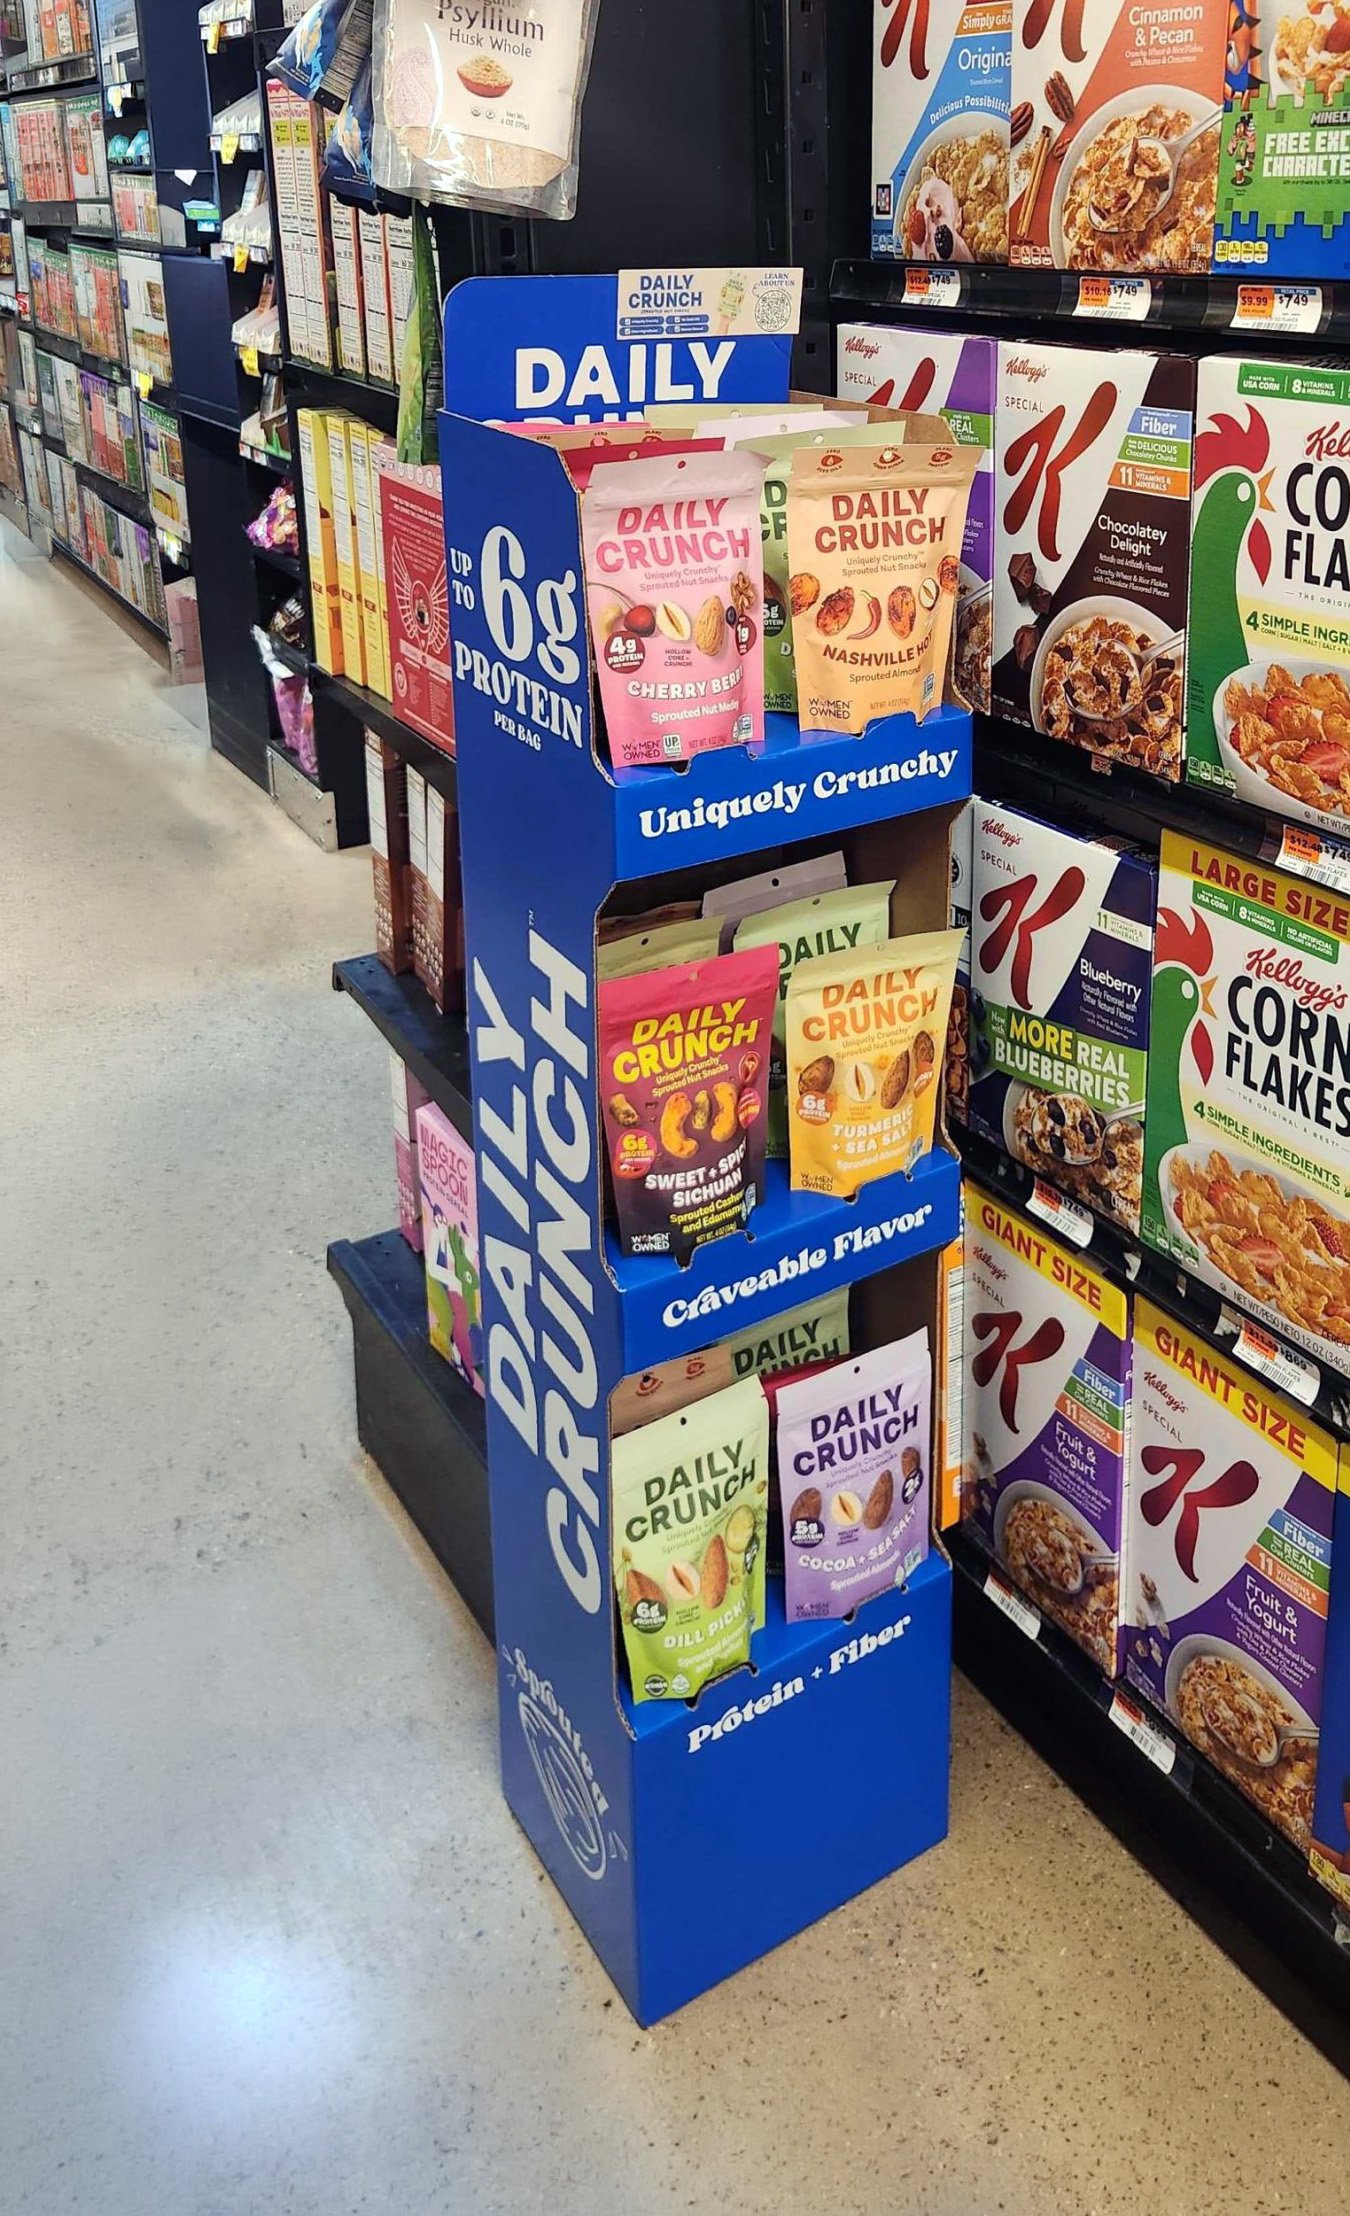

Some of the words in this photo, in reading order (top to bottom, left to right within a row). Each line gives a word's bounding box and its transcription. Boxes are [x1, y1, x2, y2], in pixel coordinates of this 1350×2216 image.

[438, 0, 544, 41] Psyllium
[962, 14, 995, 30] Simply
[1129, 4, 1203, 25] Cinnamon
[449, 28, 484, 47] Husk
[489, 36, 533, 58] Whole
[1135, 30, 1147, 46] &
[1150, 27, 1194, 47] Pecan
[930, 99, 963, 125] Delicious
[1265, 131, 1311, 155] FREE
[640, 274, 695, 291] DAILY
[764, 272, 789, 280] LEARN
[628, 292, 703, 309] CRUNCH
[1241, 295, 1268, 307] $9.99
[844, 336, 882, 358] Kellogg's
[515, 341, 737, 410] DAILY
[844, 371, 877, 387] SPECIAL
[1005, 358, 1050, 383] Kellogg's
[1242, 380, 1258, 389] USA
[1258, 382, 1280, 391] CORN
[1292, 379, 1302, 394] 8
[1302, 380, 1334, 390] VITAMINS
[1004, 396, 1044, 414] SPECIAL
[950, 419, 974, 434] REAL
[1140, 416, 1177, 436] Fiber
[1125, 448, 1156, 461] Chocolatey
[1156, 453, 1178, 463] Chunks
[1138, 440, 1178, 455] DELICIOUS
[1120, 466, 1133, 486] 11
[1135, 471, 1166, 485] VITAMINS
[1135, 479, 1167, 492] MINERALS
[617, 497, 729, 535] DAILY
[832, 488, 930, 522] DAILY
[814, 516, 946, 554] CRUNCH
[1098, 514, 1168, 546] Chocolatey
[1110, 534, 1152, 557] Delight
[450, 547, 473, 577] UP
[595, 528, 750, 573] CRUNCH
[842, 565, 879, 577] Sprouted
[880, 563, 897, 572] Nut
[452, 579, 475, 611] TO
[480, 525, 581, 685] 6g
[1246, 610, 1259, 631] 4
[1262, 613, 1310, 636] SIMPLE
[607, 653, 644, 665] PROTEIN
[610, 636, 637, 655] 4g
[823, 644, 914, 667] NASHVILLE
[454, 640, 583, 749] PROTEIN
[627, 681, 708, 699] CHERRY
[809, 707, 850, 719] OWNED
[493, 709, 516, 740] PER
[517, 725, 542, 752] BAG
[624, 749, 660, 760] OWNED
[639, 780, 807, 838] Uniquely
[813, 749, 959, 799] Crunchy
[981, 819, 1024, 847] Kellogg's
[980, 850, 1017, 876] SPECIAL
[1190, 850, 1278, 906] LARGE
[1285, 888, 1350, 936] SIZE
[1239, 906, 1248, 920] 8
[778, 923, 862, 970] DAILY
[1287, 926, 1298, 937] NO
[1298, 930, 1333, 951] ARTIFICIAL
[822, 966, 925, 1010] DAILY
[1080, 958, 1142, 1003] Blueberry
[1245, 948, 1349, 1012] Kellogg's
[631, 998, 747, 1045] DAILY
[801, 987, 938, 1042] CRUNCH
[991, 1010, 1006, 1024] Now
[1228, 975, 1350, 1083] CORN
[612, 1021, 759, 1084] CRUNCH
[1009, 1012, 1073, 1060] MORE
[1077, 1040, 1130, 1080] REAL
[652, 1077, 685, 1098] Sprouted
[685, 1073, 699, 1088] Nut
[699, 1064, 729, 1081] Snacks
[995, 1037, 1130, 1109] BLUEBERRIES
[1226, 1031, 1350, 1137] FLAKES
[802, 1094, 826, 1111] 6g
[832, 1103, 914, 1138] TURMERIC
[845, 1139, 878, 1154] SEA
[881, 1119, 914, 1145] SALT
[420, 1123, 468, 1175] MAGIC
[622, 1133, 648, 1150] 6g
[1193, 1100, 1206, 1119] 4
[1207, 1105, 1250, 1138] SIMPLE
[1252, 1131, 1341, 1187] INGREDIENTS
[421, 1150, 469, 1208] SPOON
[645, 1166, 707, 1190] SWEET
[672, 1168, 743, 1208] SICHUAN
[801, 1180, 833, 1192] OWNED
[473, 957, 540, 1457] DAILY
[632, 1241, 670, 1252] OWNED
[973, 1246, 1010, 1281] Kellogg's
[982, 1204, 1047, 1267] GIANT
[1051, 1255, 1103, 1312] SIZE
[527, 928, 602, 1615] CRUNCH
[662, 1247, 827, 1328] Craveable
[833, 1204, 933, 1260] Flavor
[972, 1272, 1005, 1308] SPECIAL
[733, 1317, 822, 1376] DAILY
[1084, 1368, 1117, 1400] Fiber
[1144, 1370, 1188, 1414] Kellogg's
[1154, 1325, 1238, 1402] GIANT
[1241, 1391, 1306, 1460] SIZE
[810, 1383, 904, 1443] DAILY
[1065, 1399, 1078, 1423] 11
[1084, 1389, 1109, 1414] REAL
[1141, 1399, 1183, 1443] SPECIAL
[793, 1405, 919, 1477] CRUNCH
[1055, 1420, 1084, 1455] Fruit
[1086, 1446, 1098, 1465] &
[643, 1439, 744, 1507] DAILY
[1055, 1436, 1096, 1481] Yogurt
[625, 1457, 757, 1543] CRUNCH
[798, 1554, 856, 1572] COCOA
[868, 1535, 893, 1560] SEA
[892, 1505, 915, 1540] SALT
[1283, 1520, 1325, 1558] Fiber
[1284, 1542, 1315, 1573] REAL
[1245, 1574, 1282, 1615] Fruit
[1285, 1605, 1298, 1628] &
[1245, 1591, 1297, 1645] Yogurt
[663, 1628, 705, 1649] DILL
[687, 1675, 806, 1755] Protein
[828, 1615, 912, 1675] Fiber
